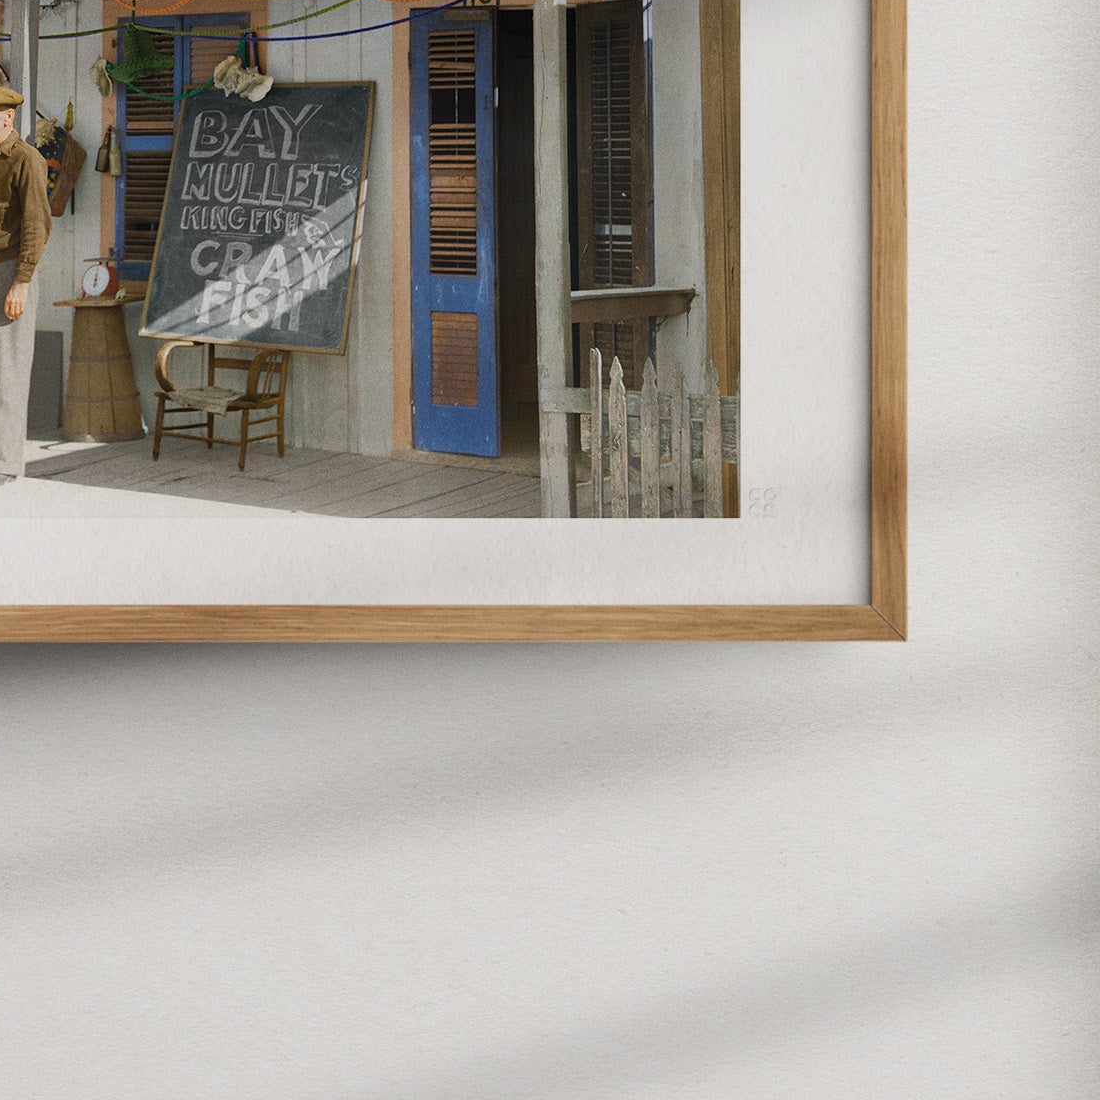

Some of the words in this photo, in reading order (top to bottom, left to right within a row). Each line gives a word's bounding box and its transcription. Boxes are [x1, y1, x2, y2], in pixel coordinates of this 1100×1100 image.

[188, 103, 324, 161] BAY
[190, 238, 342, 291] CRAW
[195, 279, 304, 332] FISH
